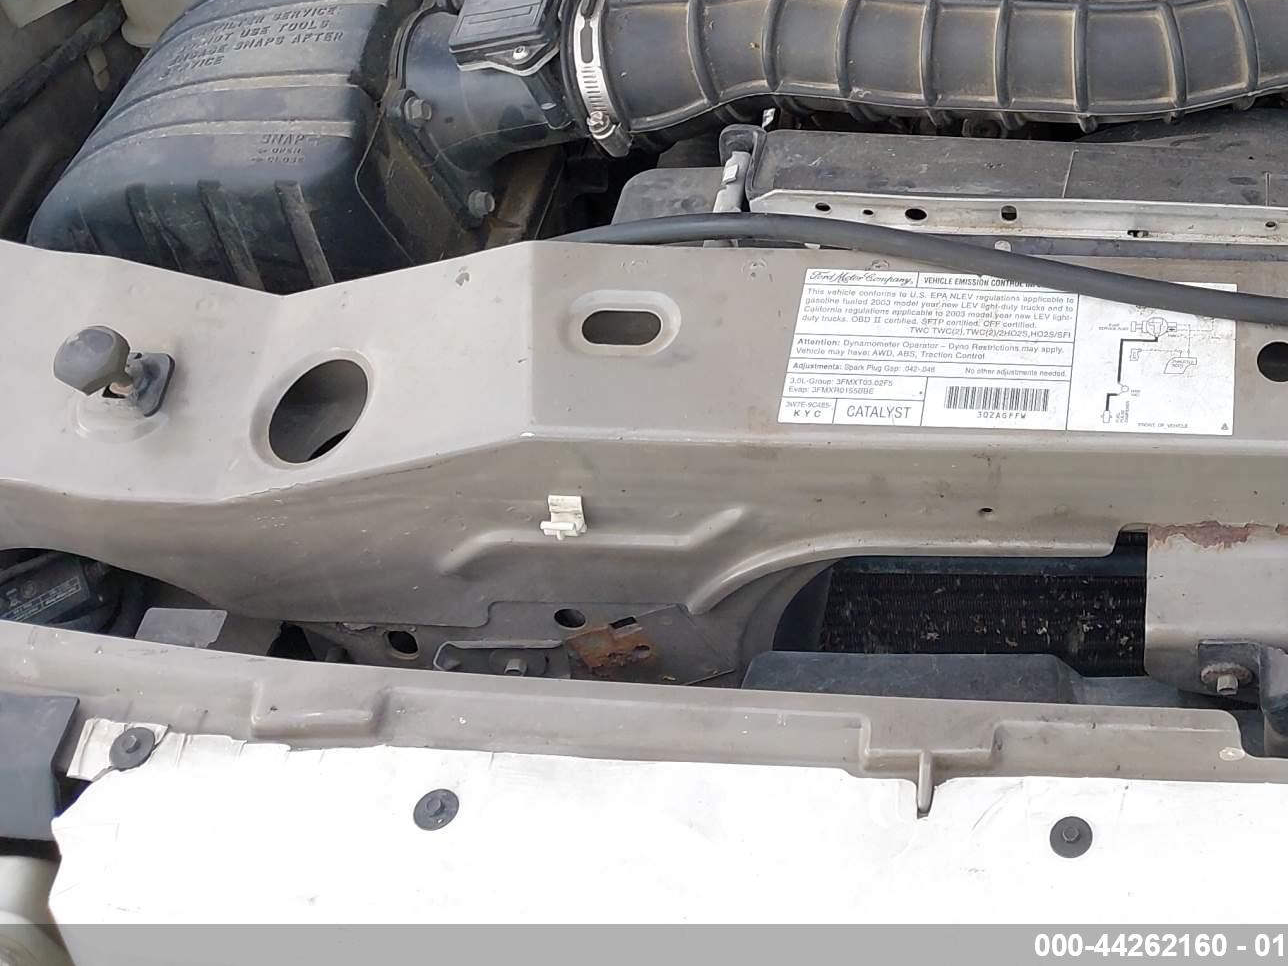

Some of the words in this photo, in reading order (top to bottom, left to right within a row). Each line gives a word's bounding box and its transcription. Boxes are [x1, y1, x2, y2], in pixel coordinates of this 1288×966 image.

[240, 25, 271, 38] USE
[278, 19, 331, 33] TOOLS
[234, 36, 286, 50] SNAPS
[290, 31, 345, 44] AFTER
[262, 133, 305, 145] SNAP
[809, 271, 834, 283] Ford
[833, 272, 863, 284] Motor
[924, 276, 952, 285] VEHICLE
[954, 277, 989, 286] EMISSION
[805, 298, 839, 306] gasoline
[842, 298, 868, 306] fueled
[870, 299, 891, 307] 2003
[893, 299, 919, 307] model
[921, 301, 941, 309] year
[980, 302, 1018, 311] light-duty
[1020, 303, 1045, 312] trucks
[1048, 304, 1063, 312] and
[975, 294, 1020, 302] regulations
[1023, 295, 1064, 304] applicable
[803, 305, 842, 314] California
[845, 307, 889, 316] regulations
[891, 308, 933, 317] applicable
[945, 310, 965, 318] 2003
[967, 311, 992, 319] model
[1033, 313, 1051, 321] LEV
[802, 314, 820, 323] duty
[821, 315, 848, 323] trucks.
[921, 318, 944, 326] SFTP
[797, 338, 841, 346] Attention:
[843, 339, 900, 349] Dynamometer
[902, 341, 938, 349] Operator
[948, 342, 969, 351] Dyno
[972, 343, 1019, 352] Restrictions
[872, 349, 895, 357] AWD,
[920, 351, 953, 359] Traction
[955, 352, 985, 360] Control
[793, 362, 842, 370] Adjustments:
[844, 363, 864, 372] Spark
[866, 364, 882, 372] Plug
[997, 369, 1038, 377] adjustments
[788, 386, 811, 394] Evap:
[846, 405, 912, 419] CATALYST
